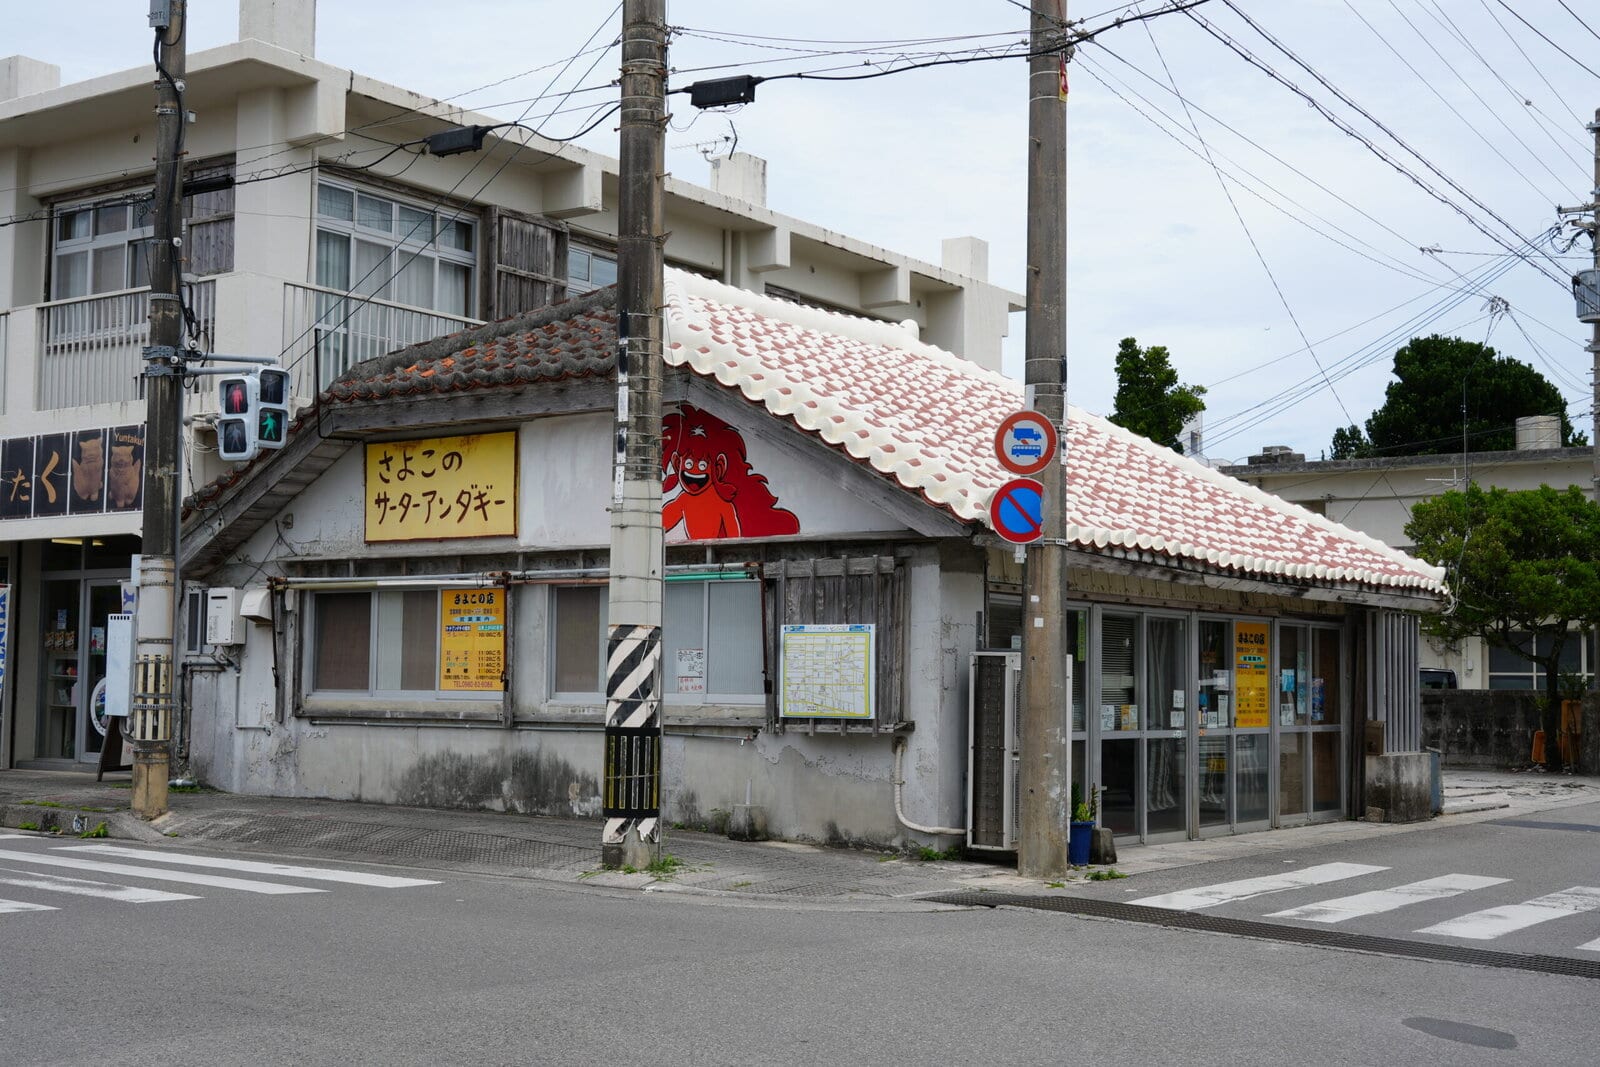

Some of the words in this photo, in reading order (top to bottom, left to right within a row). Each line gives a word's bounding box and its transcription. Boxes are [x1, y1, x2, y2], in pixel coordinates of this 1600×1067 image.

[378, 449, 463, 484] さよこの
[374, 483, 506, 525] サーターアンダギー
[454, 592, 495, 605] さよこの店
